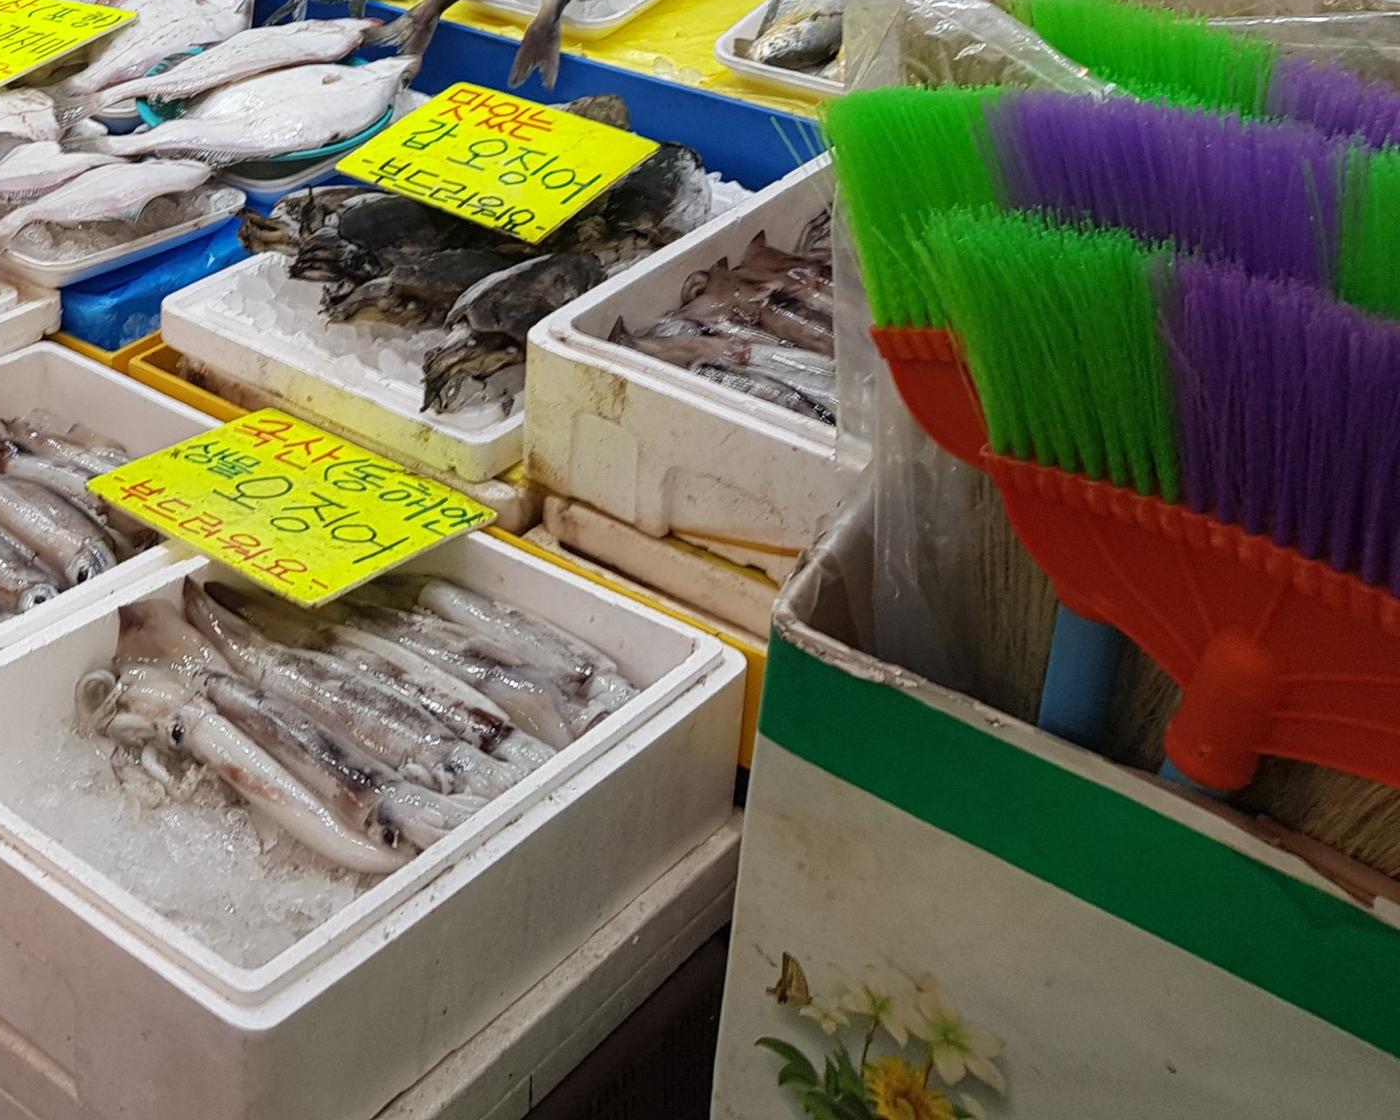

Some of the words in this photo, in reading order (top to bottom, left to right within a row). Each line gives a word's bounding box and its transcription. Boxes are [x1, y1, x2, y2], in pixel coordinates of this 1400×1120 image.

[27, 2, 123, 30] (포항)
[439, 87, 553, 142] 맛있는
[186, 440, 262, 481] 생물
[241, 417, 345, 471] 국산
[322, 457, 485, 539] (동해안)
[212, 475, 409, 565] 오징어
